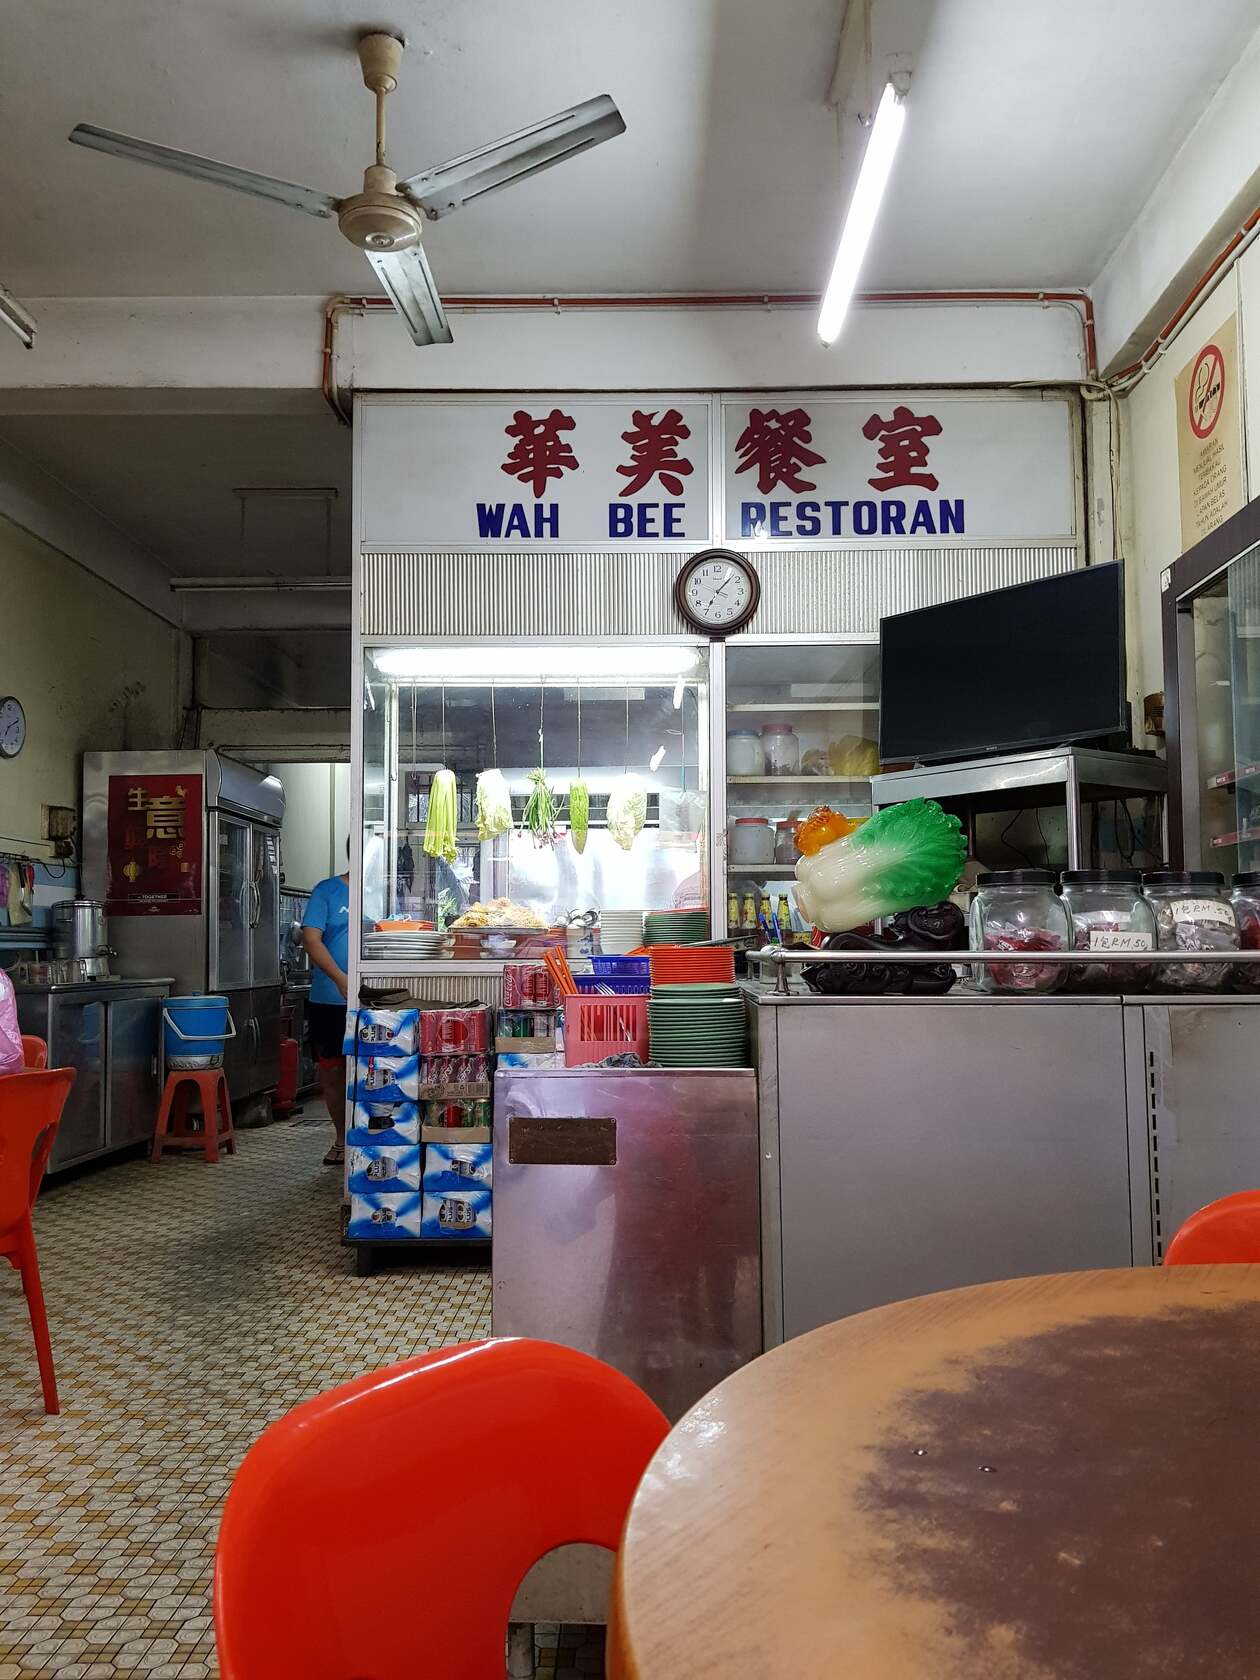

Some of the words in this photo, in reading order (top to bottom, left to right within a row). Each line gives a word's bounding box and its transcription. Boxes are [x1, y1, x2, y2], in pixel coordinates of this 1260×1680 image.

[476, 503, 559, 538] WAH
[608, 503, 686, 538] BEE
[741, 499, 965, 537] RESTORAN
[702, 569, 709, 577] 11
[713, 565, 722, 573] 12
[694, 577, 702, 585] 10
[734, 576, 741, 584] 2
[691, 588, 698, 597] 9
[737, 587, 744, 596] 3
[695, 599, 702, 607] 8
[734, 599, 741, 607] 4
[703, 608, 710, 616] 7
[715, 611, 722, 619] 6
[726, 608, 733, 616] 5
